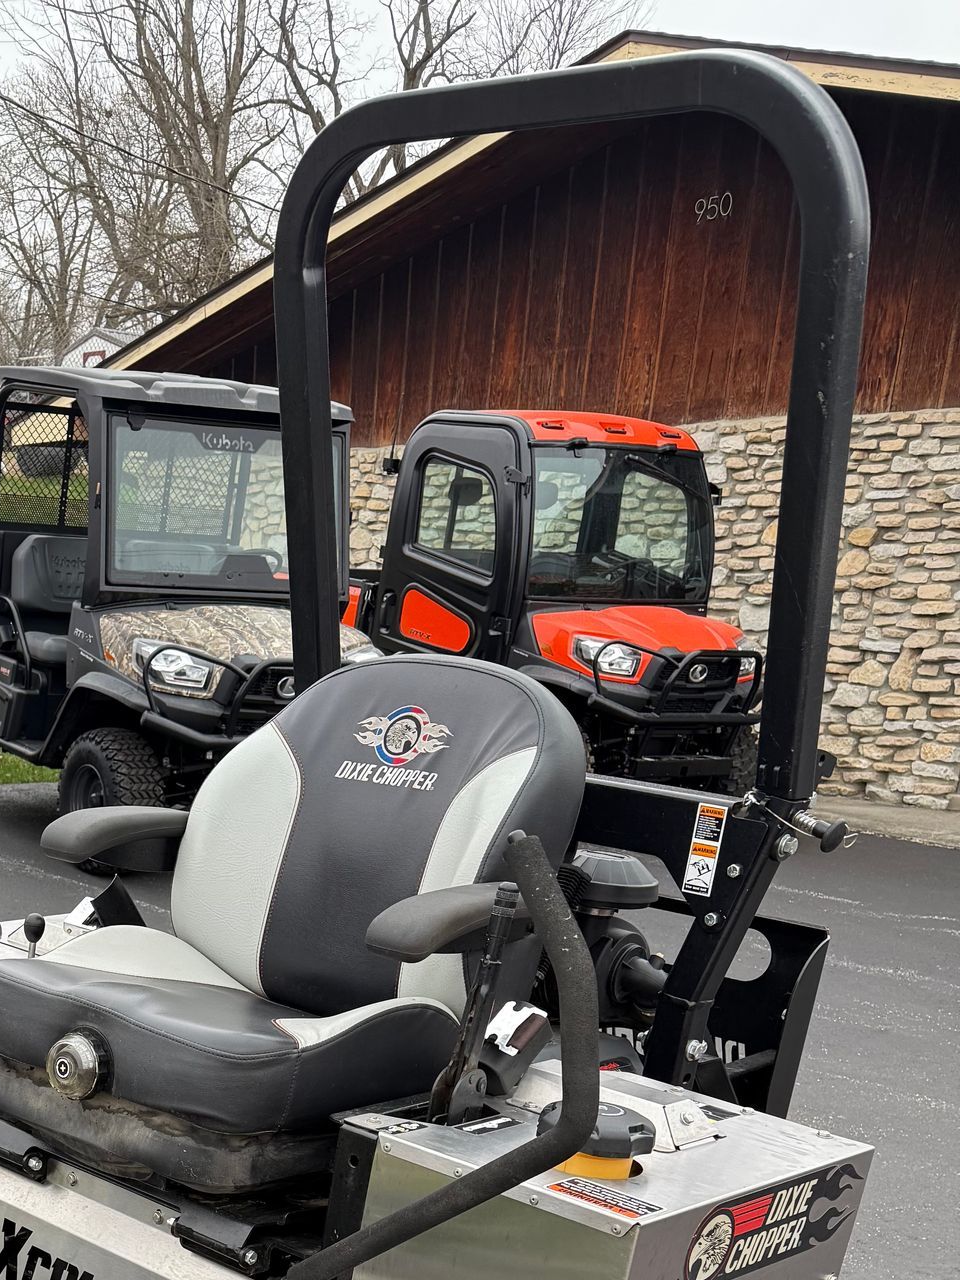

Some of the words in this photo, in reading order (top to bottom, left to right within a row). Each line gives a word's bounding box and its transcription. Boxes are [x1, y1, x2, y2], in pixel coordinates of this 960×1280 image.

[694, 192, 733, 223] 950
[202, 432, 255, 452] Kubota
[334, 760, 377, 781] DIXIE
[373, 765, 439, 791] CHOPPER
[765, 1178, 819, 1226] DIXIE
[725, 1216, 807, 1274] CHOPPER
